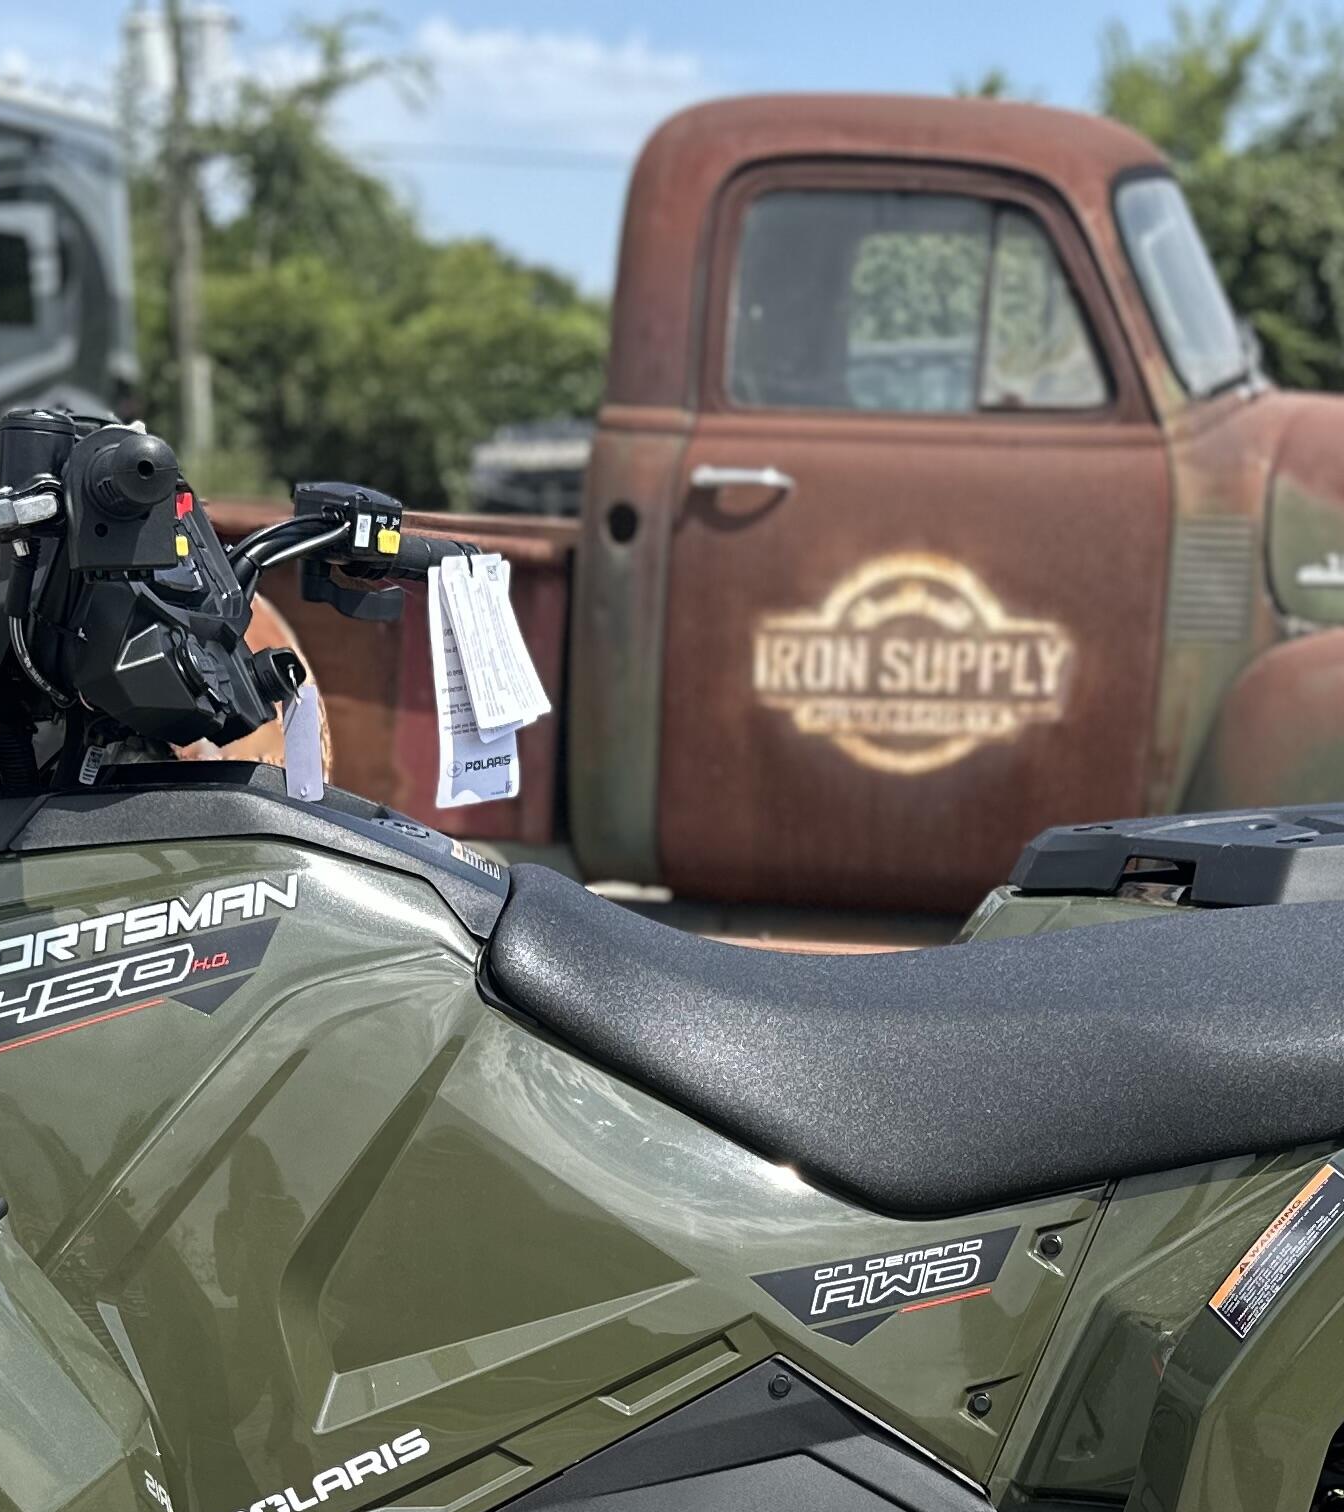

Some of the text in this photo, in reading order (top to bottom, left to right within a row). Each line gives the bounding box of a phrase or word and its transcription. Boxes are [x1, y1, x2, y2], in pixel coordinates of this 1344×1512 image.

[752, 634, 1066, 695] IRON SUPPLY
[464, 754, 512, 773] POLARIS
[191, 951, 231, 974] H.O.
[1249, 1199, 1303, 1259] WARNING
[809, 1253, 981, 1316] AWD
[814, 1238, 983, 1281] ON DEMAND
